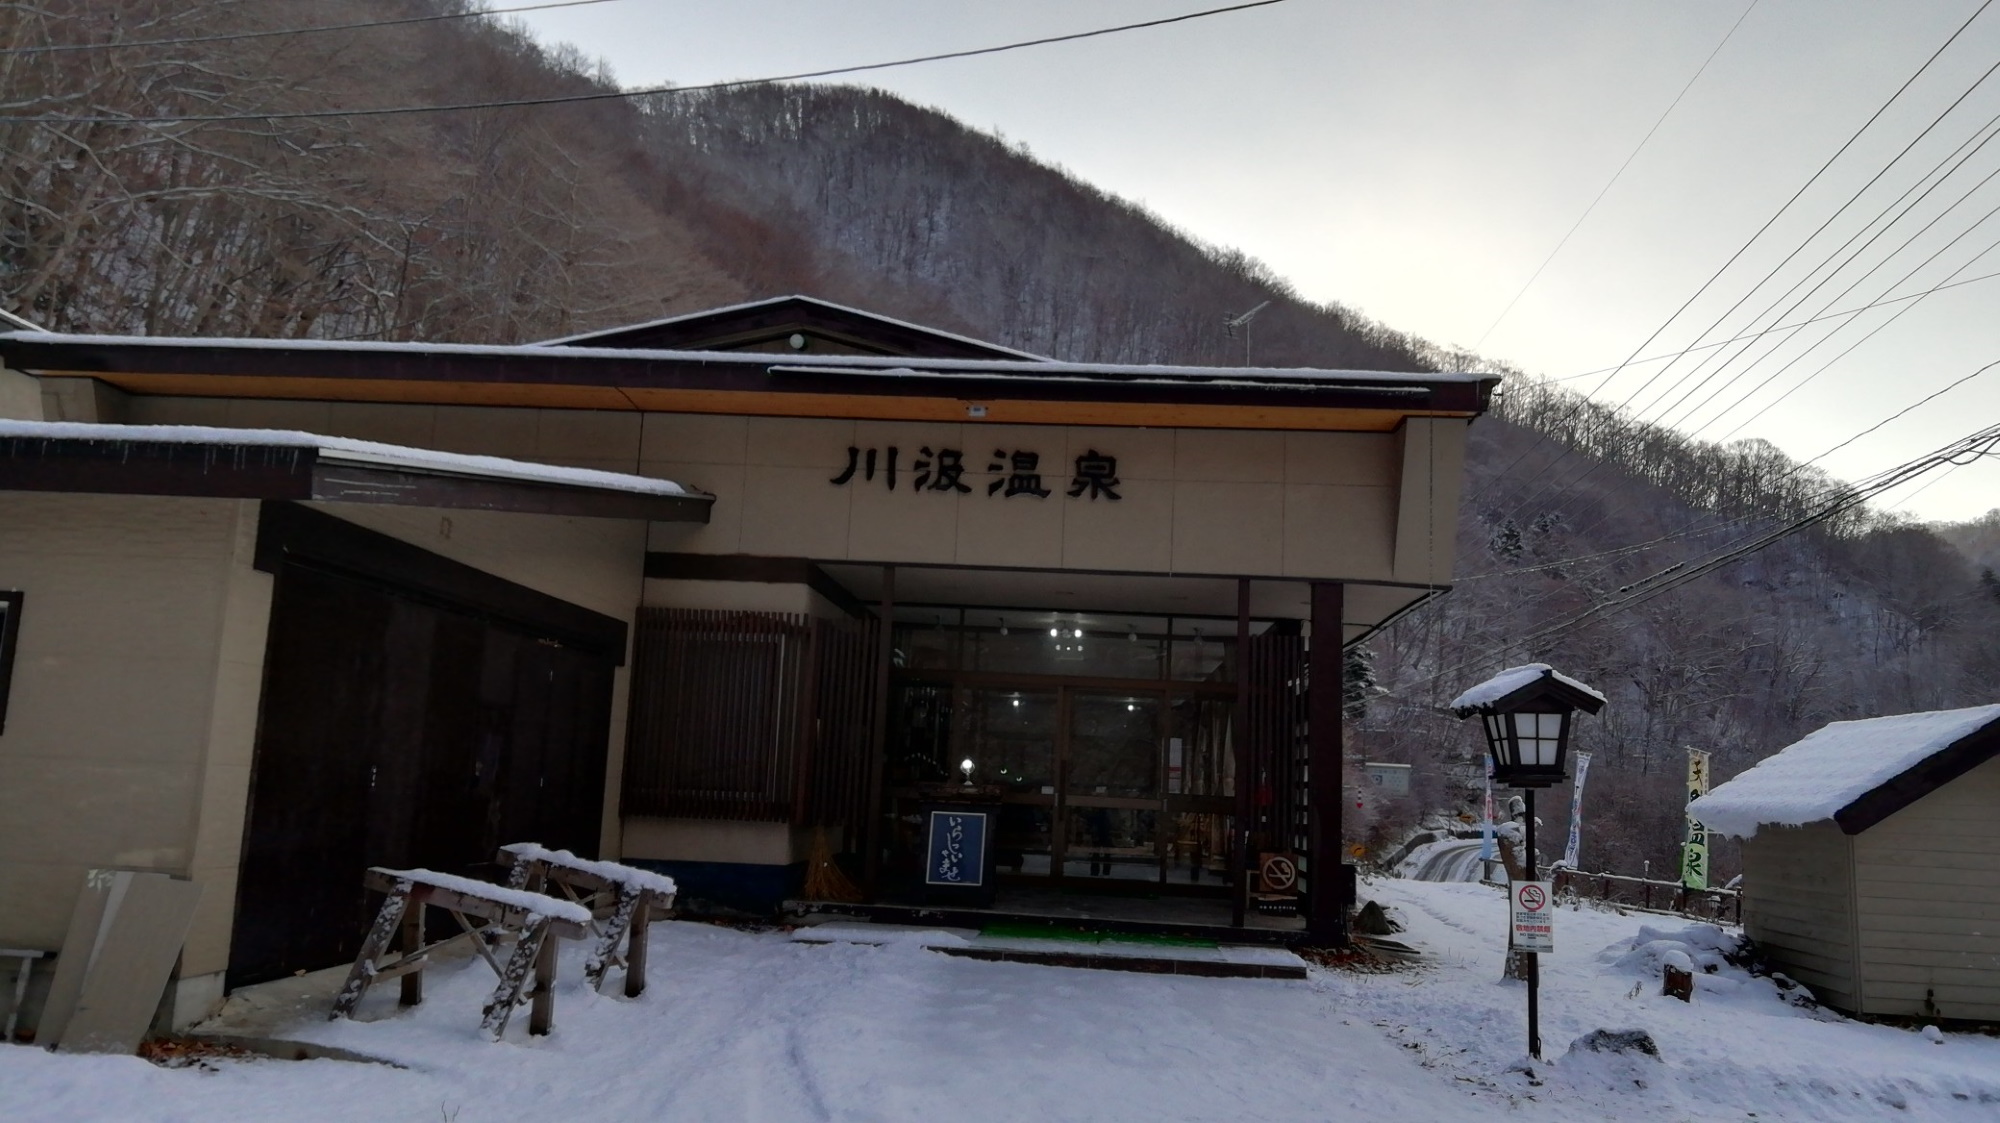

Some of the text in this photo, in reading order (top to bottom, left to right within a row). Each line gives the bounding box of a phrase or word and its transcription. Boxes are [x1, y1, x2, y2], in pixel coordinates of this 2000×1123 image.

[830, 446, 1121, 500] 川汲温泉
[939, 816, 963, 881] いらっしゃいませ
